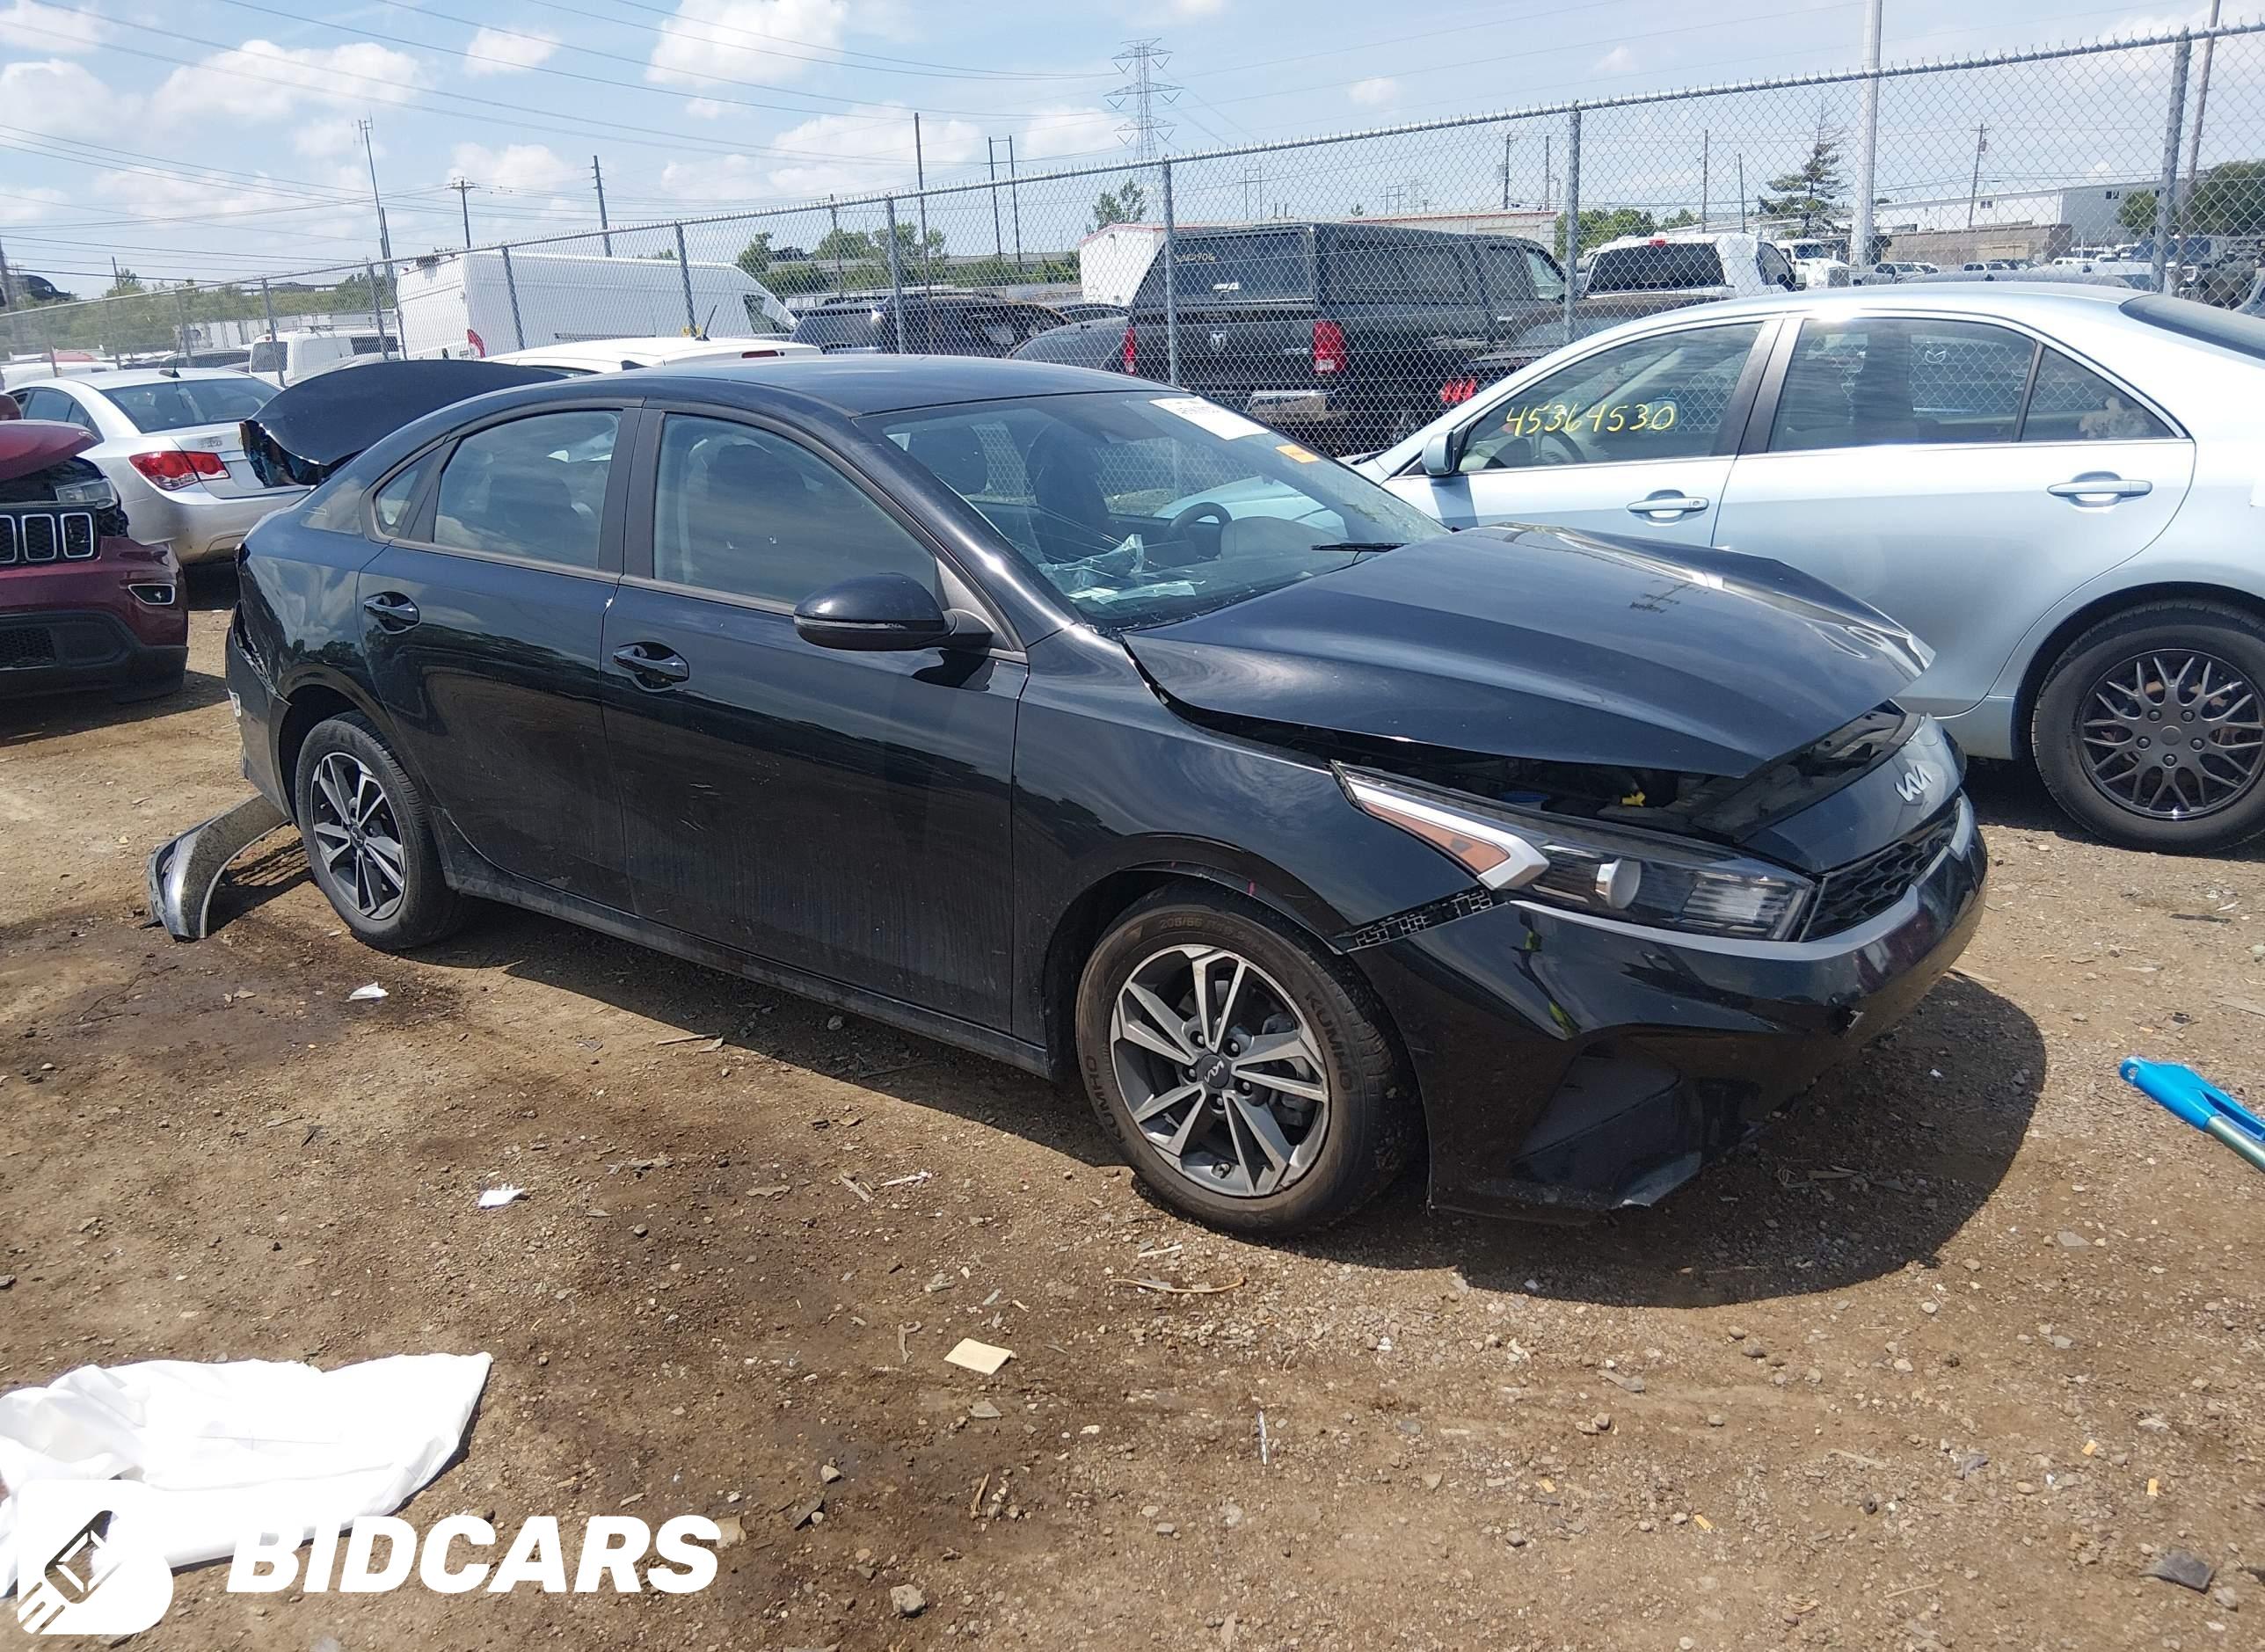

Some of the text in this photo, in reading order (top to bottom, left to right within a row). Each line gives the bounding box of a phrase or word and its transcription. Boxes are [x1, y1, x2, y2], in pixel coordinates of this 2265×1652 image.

[1505, 403, 1675, 437] 45364530
[1304, 990, 1353, 1091] KUMHO
[1086, 1054, 1126, 1143] KUMHO
